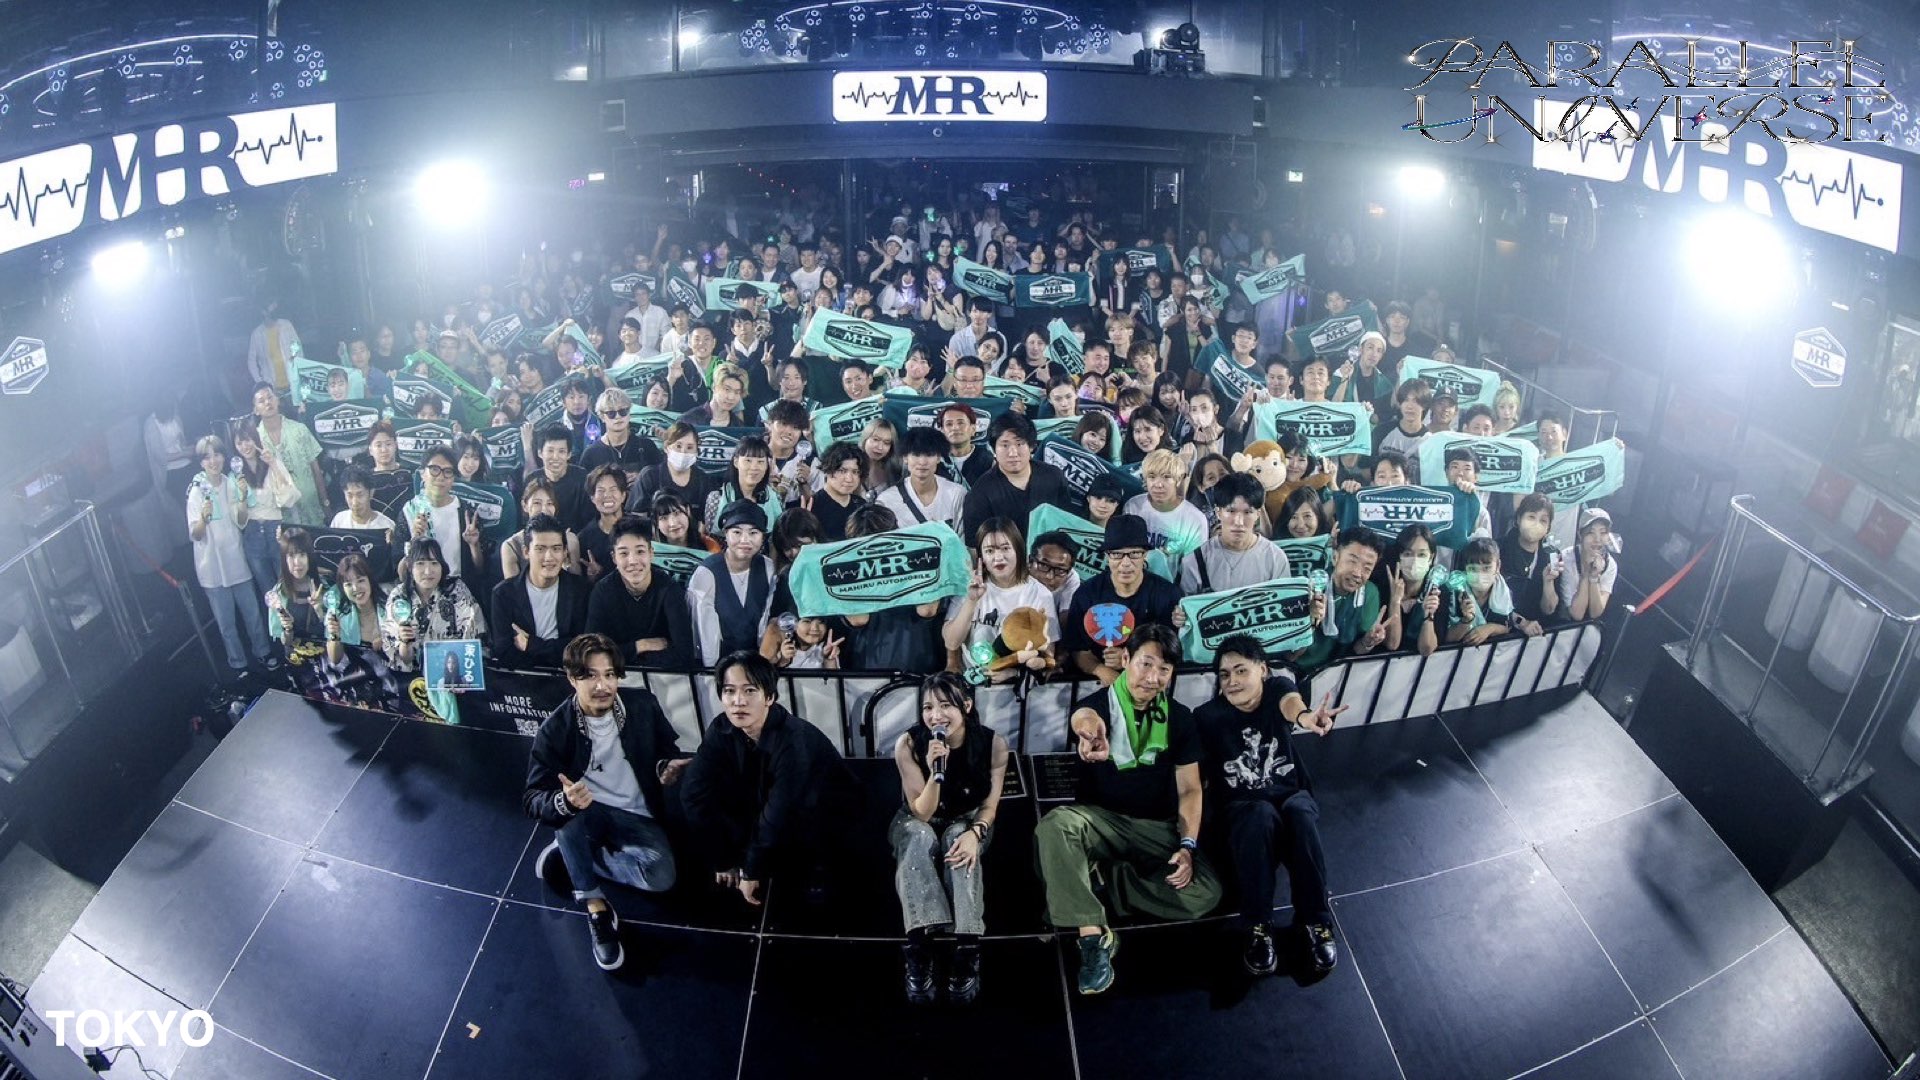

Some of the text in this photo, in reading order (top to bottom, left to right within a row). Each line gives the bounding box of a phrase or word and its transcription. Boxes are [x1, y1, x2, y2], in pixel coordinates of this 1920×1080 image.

[887, 76, 994, 115] MHR
[72, 112, 256, 233] MHR
[842, 332, 872, 346] MHR
[1326, 327, 1349, 341] MHR
[13, 355, 35, 377] MHR
[1806, 347, 1830, 368] MHR
[333, 418, 362, 430] MHR
[1298, 423, 1335, 436] MHR
[1380, 505, 1428, 520] MHR
[856, 554, 914, 580] MHR
[1076, 547, 1108, 570] MH
[839, 573, 931, 593] MAHIRU AUTOMOBILE
[1231, 603, 1287, 630] MHR
[504, 695, 533, 708] MORE
